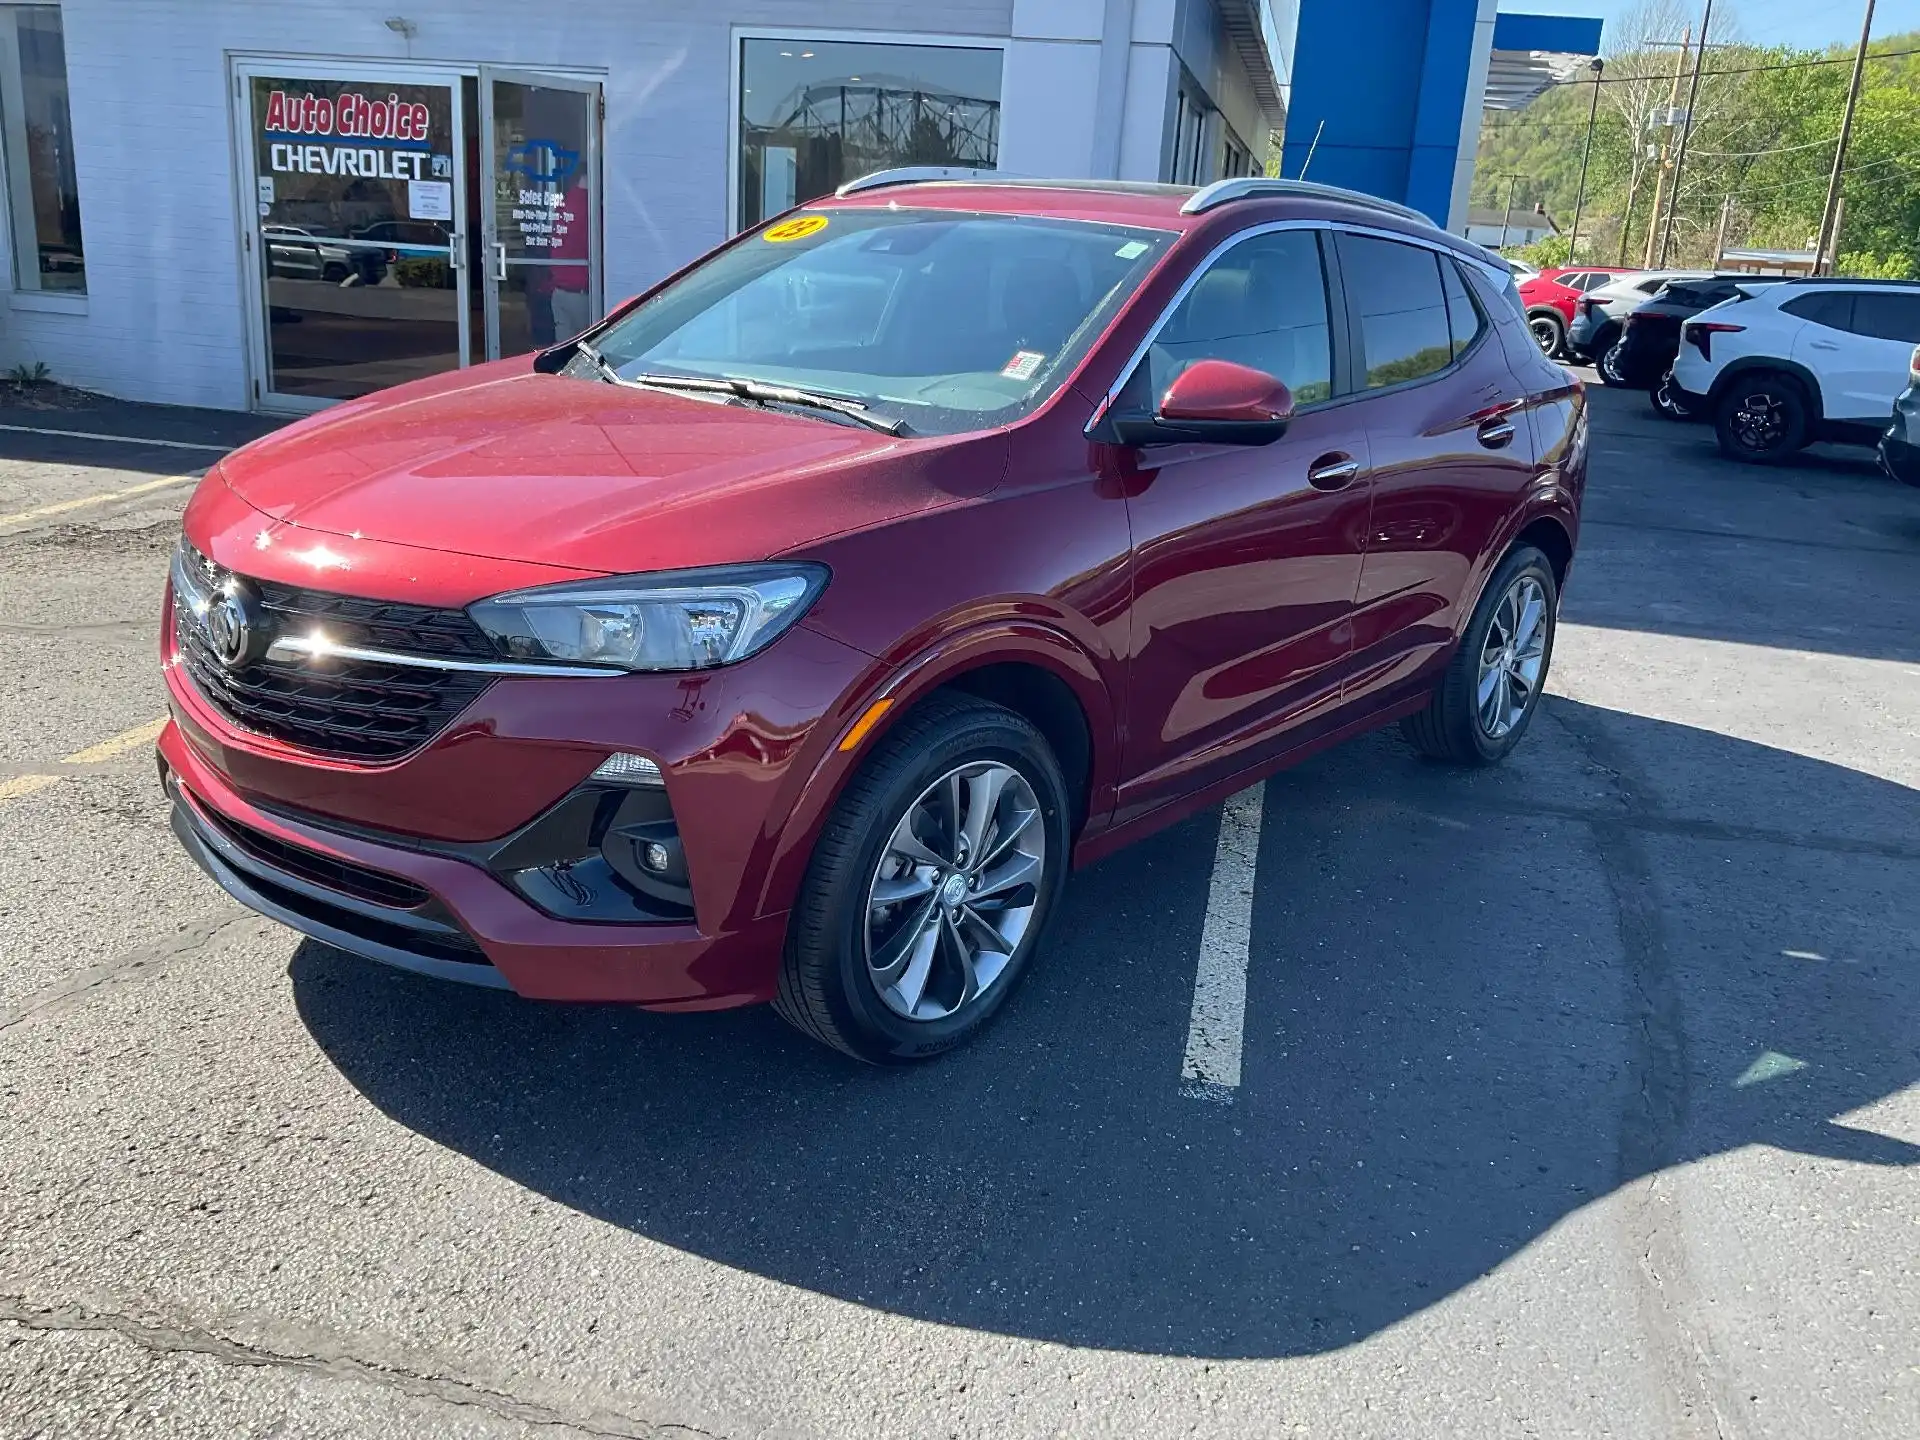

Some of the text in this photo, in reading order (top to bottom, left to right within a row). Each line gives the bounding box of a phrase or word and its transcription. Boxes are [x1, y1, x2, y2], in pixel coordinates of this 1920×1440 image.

[265, 90, 429, 141] Auto Choice
[270, 143, 427, 181] CHEVROLET
[519, 189, 566, 208] Sales Dept.
